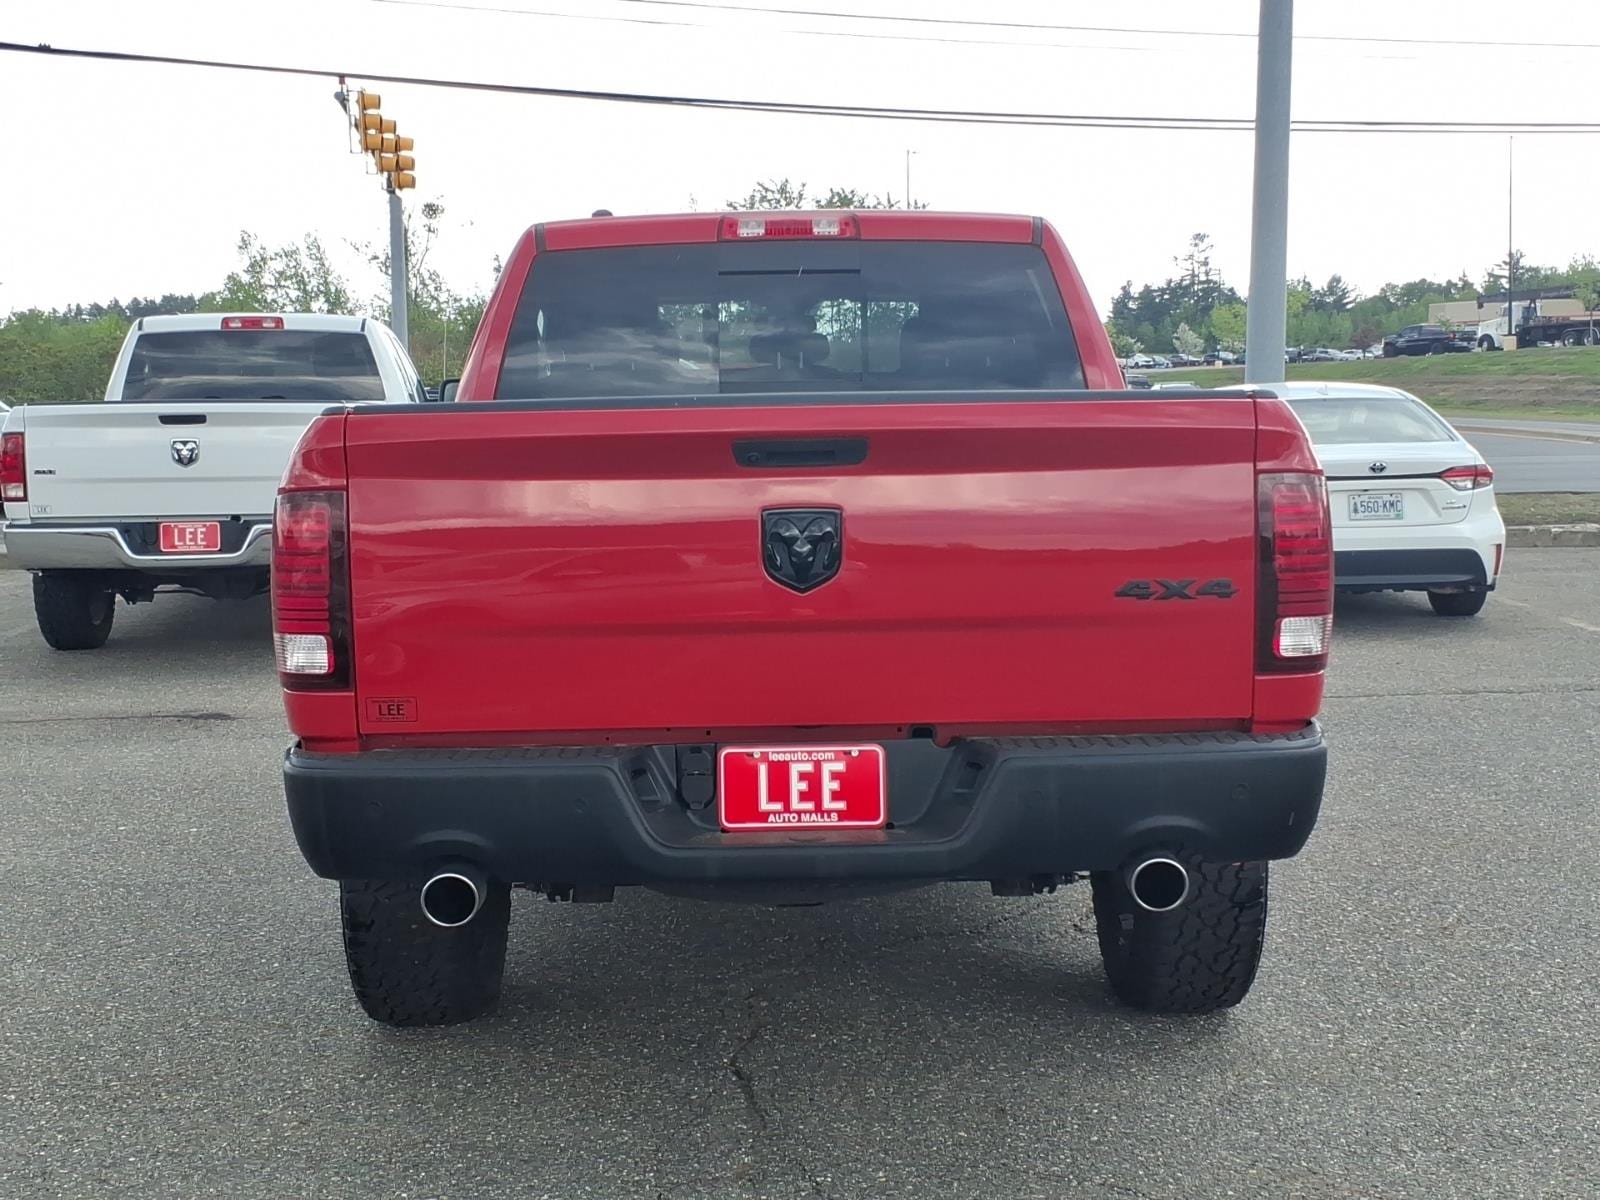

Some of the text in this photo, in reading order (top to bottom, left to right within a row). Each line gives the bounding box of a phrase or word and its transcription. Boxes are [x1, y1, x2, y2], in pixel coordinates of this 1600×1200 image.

[174, 527, 206, 545] LEE
[378, 703, 405, 716] LEE
[769, 751, 835, 761] leeauto.com
[758, 761, 847, 812] LEE
[768, 812, 838, 823] AUTO MALLS
